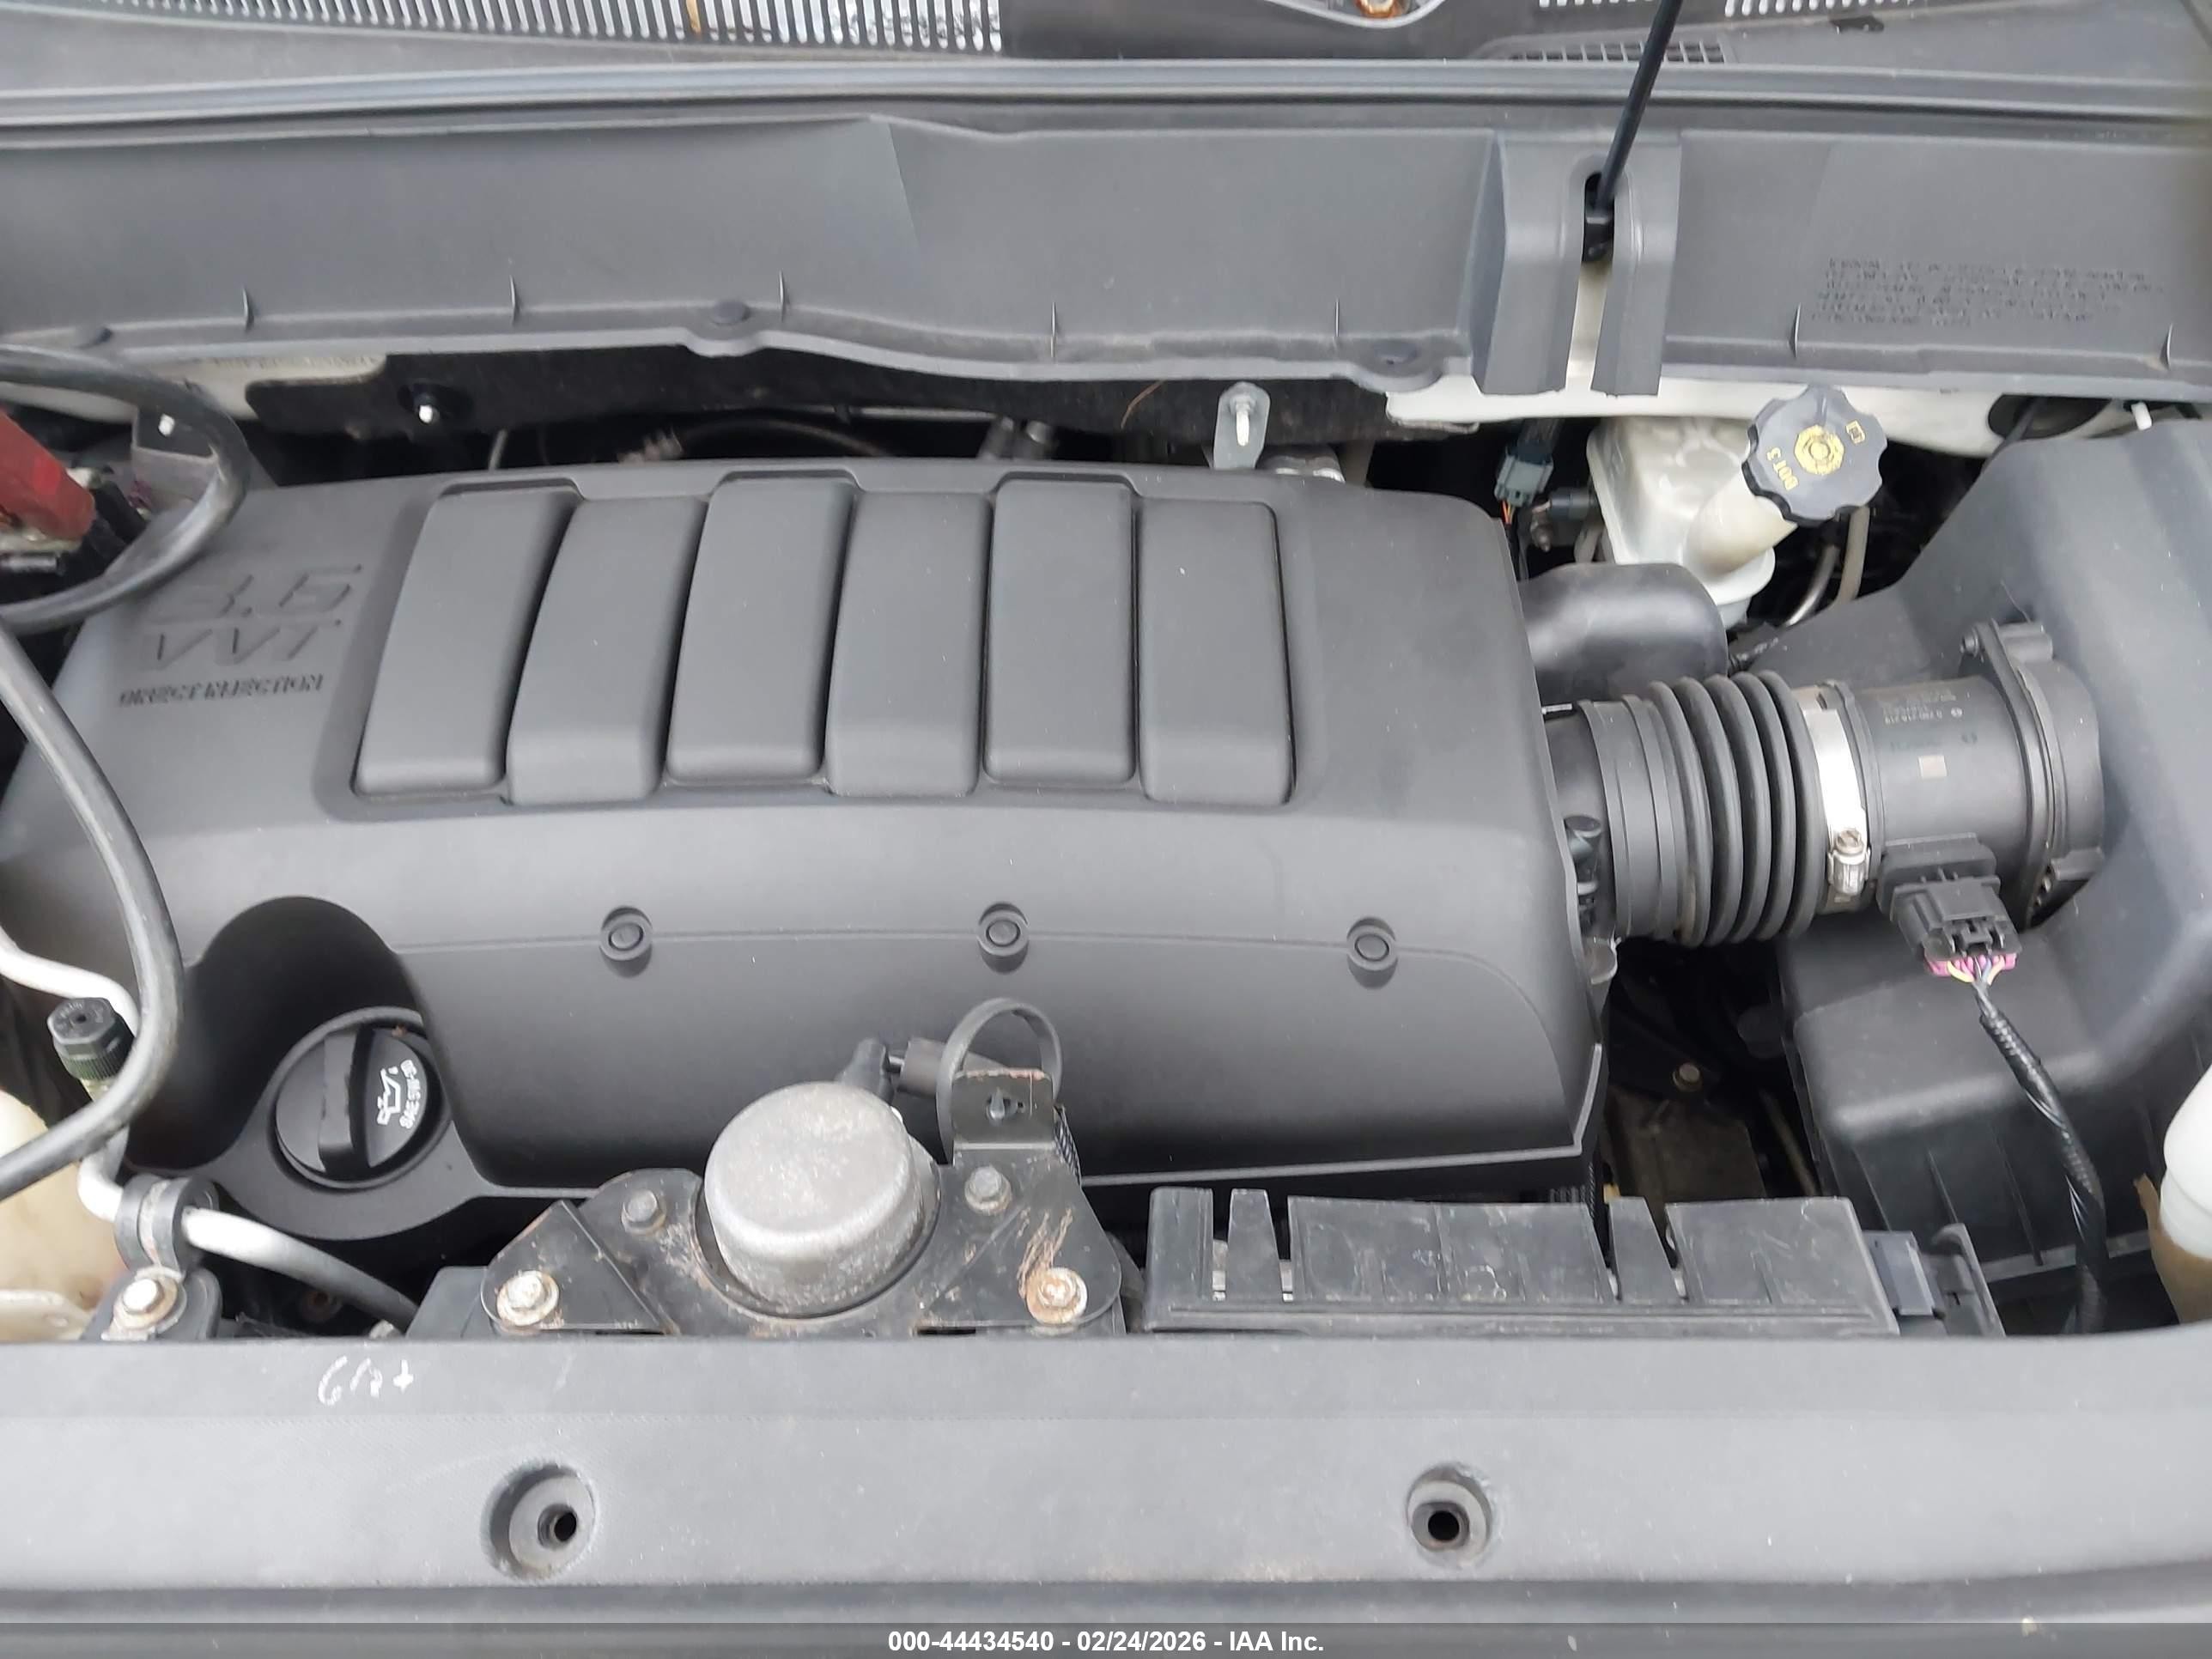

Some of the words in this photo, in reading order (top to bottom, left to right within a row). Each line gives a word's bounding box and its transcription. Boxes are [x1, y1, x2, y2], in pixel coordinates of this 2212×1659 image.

[1766, 447, 1782, 461] 3
[1771, 459, 1799, 491] DOT
[144, 562, 362, 623] 3.6
[139, 618, 342, 670] VVT
[118, 682, 201, 705] DIRECT
[204, 673, 325, 701] INJECTION
